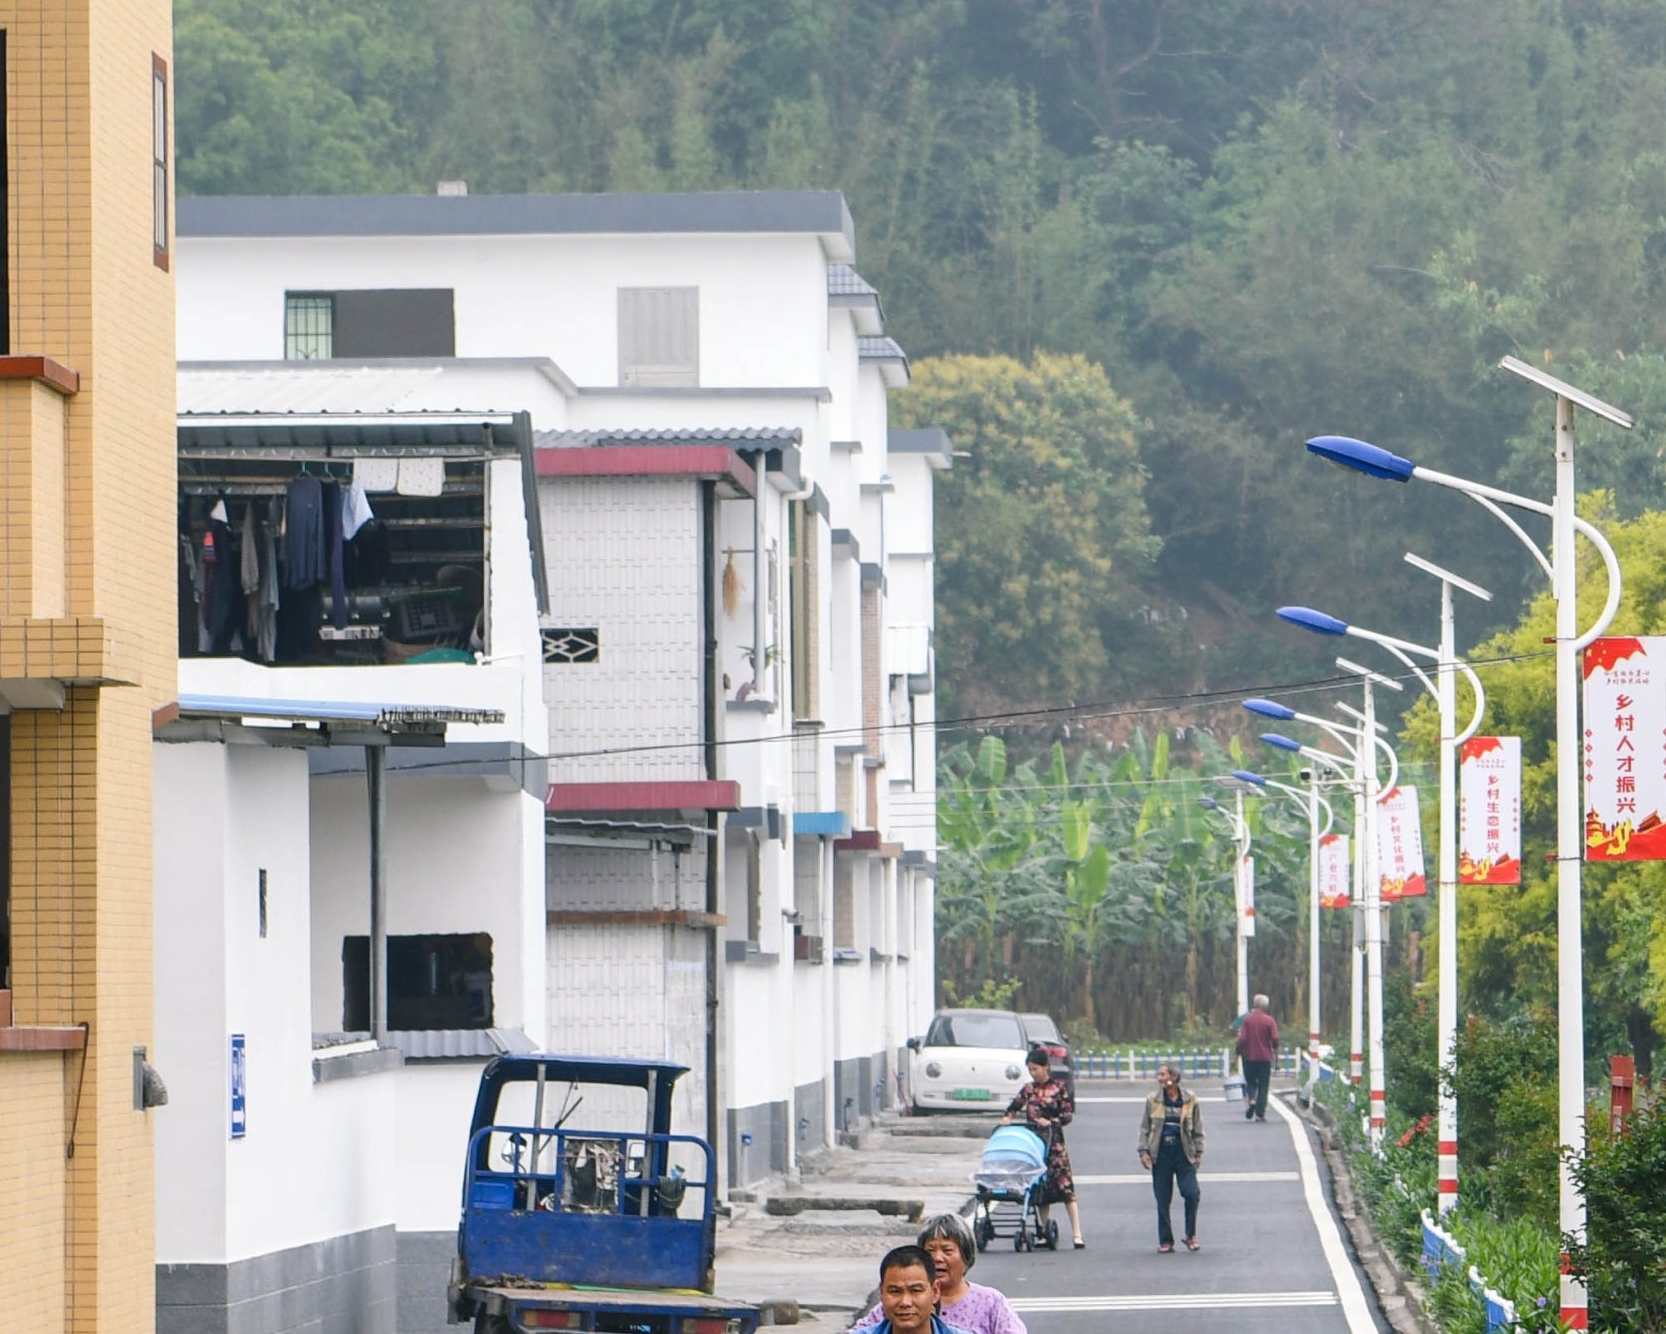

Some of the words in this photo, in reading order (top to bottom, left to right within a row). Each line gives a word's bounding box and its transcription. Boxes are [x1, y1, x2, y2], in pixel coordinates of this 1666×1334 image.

[1615, 693, 1637, 814] 乡村人才振兴
